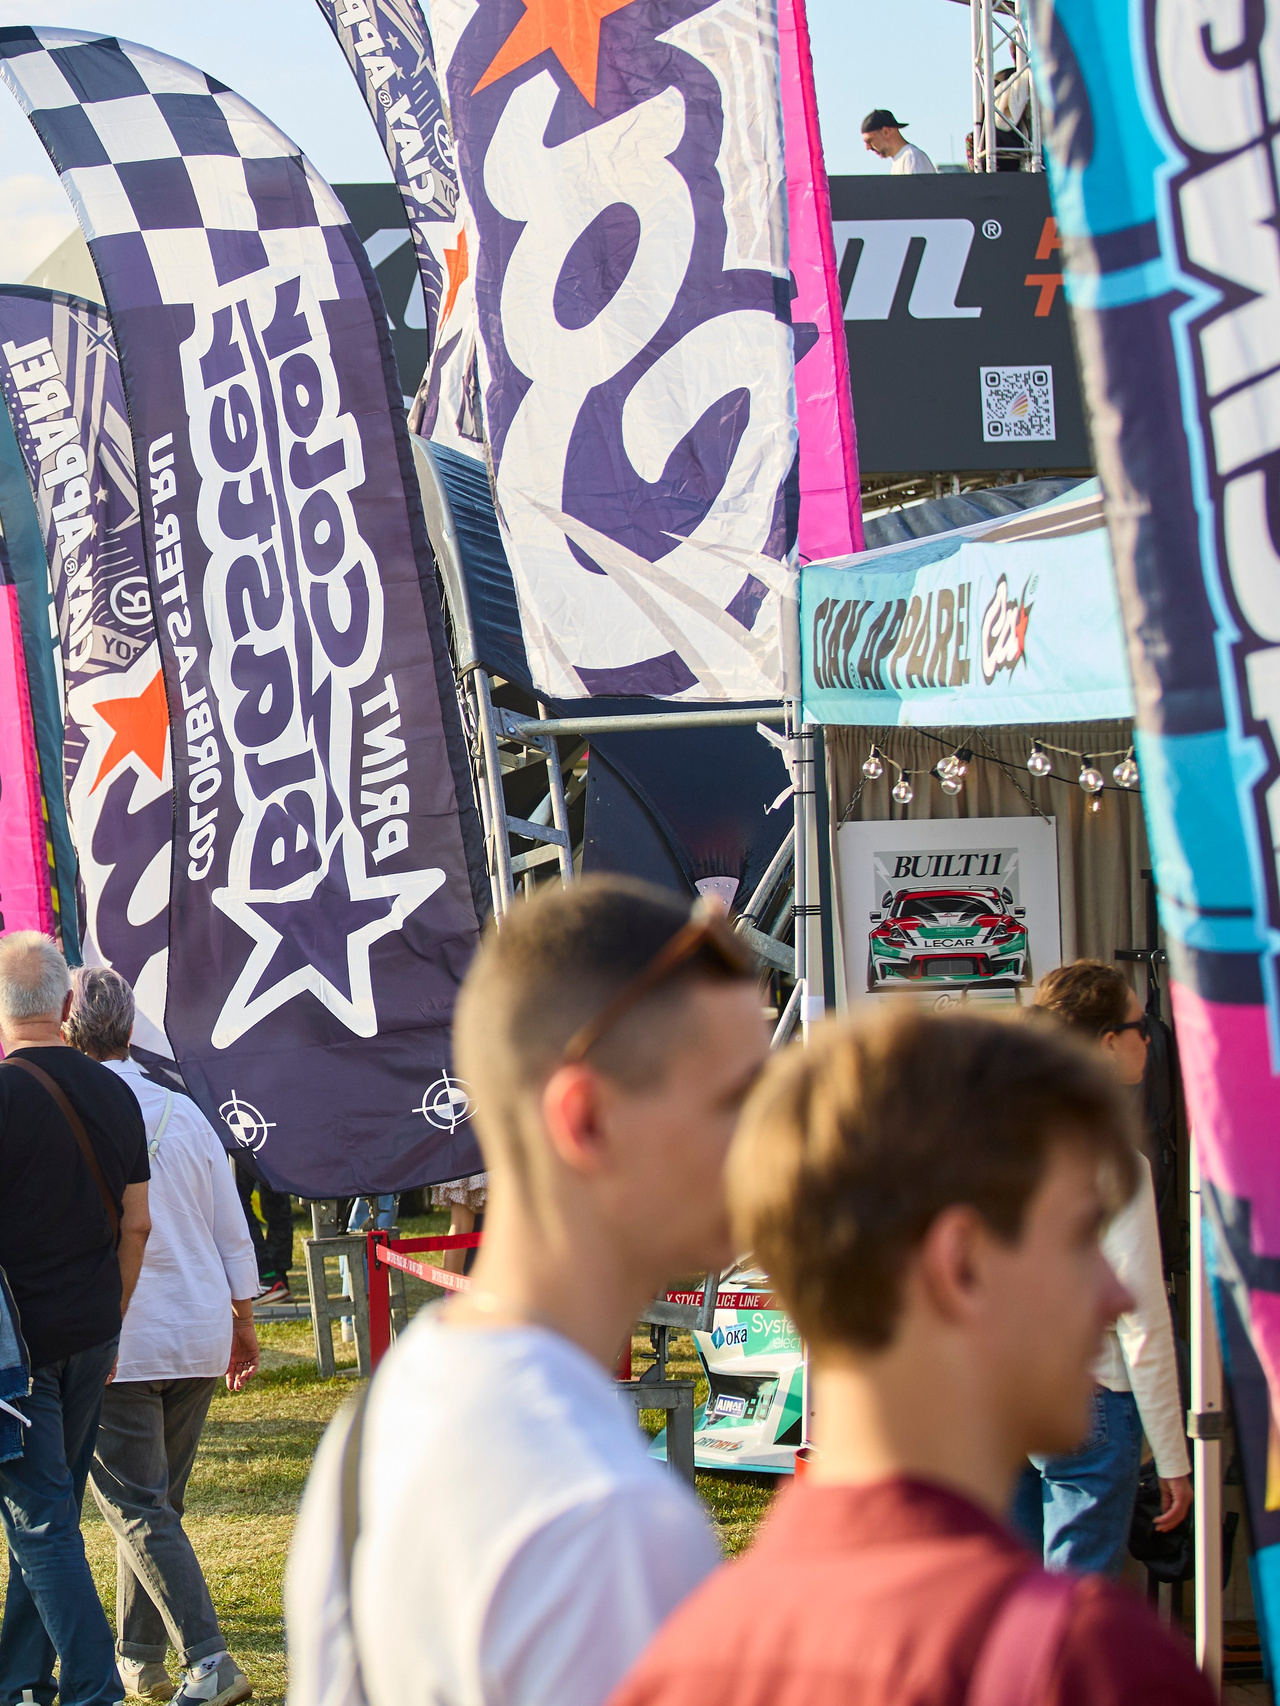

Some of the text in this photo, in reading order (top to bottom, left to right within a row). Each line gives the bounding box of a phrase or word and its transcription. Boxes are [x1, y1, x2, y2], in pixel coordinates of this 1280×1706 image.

[924, 938, 975, 948] LECAR
[674, 1293, 703, 1307] STYLE
[715, 1294, 737, 1307] LICE
[738, 1295, 761, 1307] LINE
